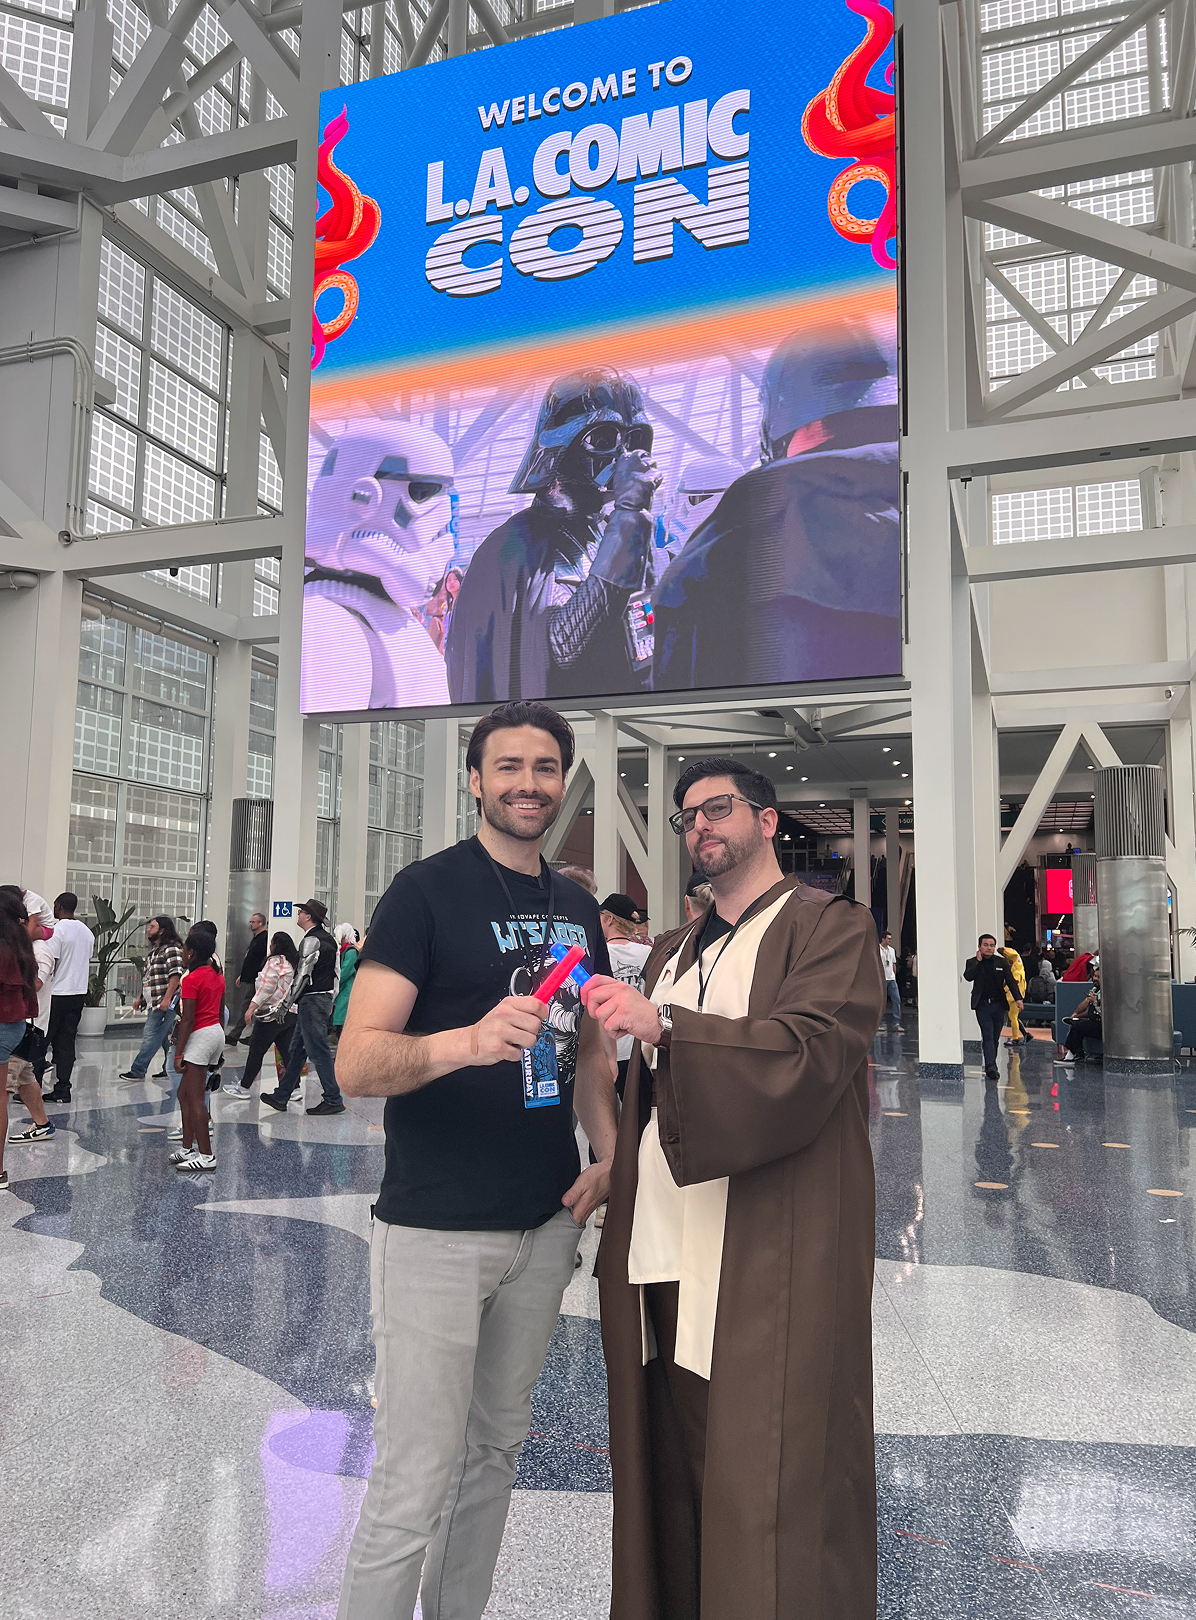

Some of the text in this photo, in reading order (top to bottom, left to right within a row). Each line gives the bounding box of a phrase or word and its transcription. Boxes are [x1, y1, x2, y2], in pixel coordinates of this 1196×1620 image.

[478, 55, 693, 132] WELCOME TO
[426, 89, 751, 226] L.A. COMIC
[425, 160, 750, 298] CON
[523, 1048, 534, 1098] ATURDAY
